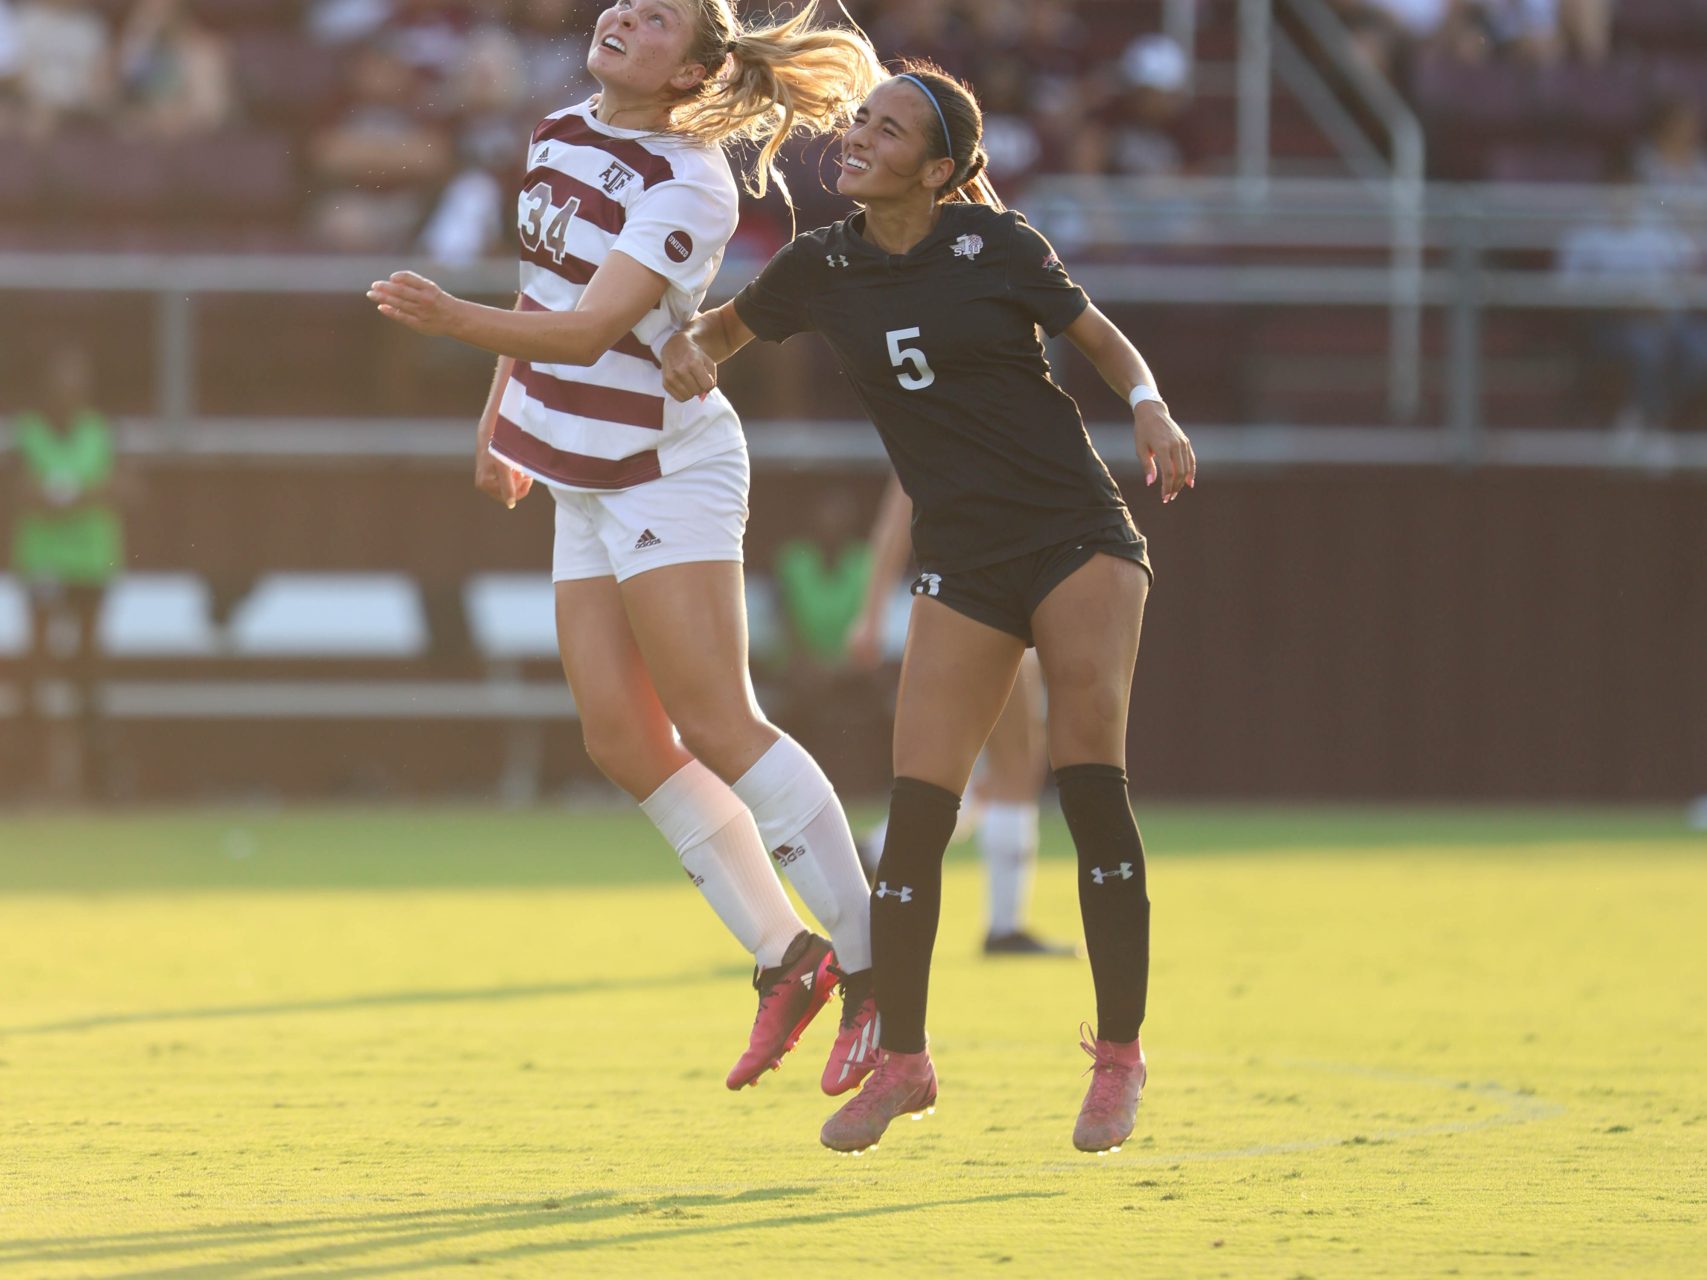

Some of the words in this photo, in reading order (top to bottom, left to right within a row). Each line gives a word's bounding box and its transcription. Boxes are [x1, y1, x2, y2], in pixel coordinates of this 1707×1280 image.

[518, 182, 582, 265] 34
[668, 235, 689, 258] UNIFIED
[886, 326, 935, 391] 5
